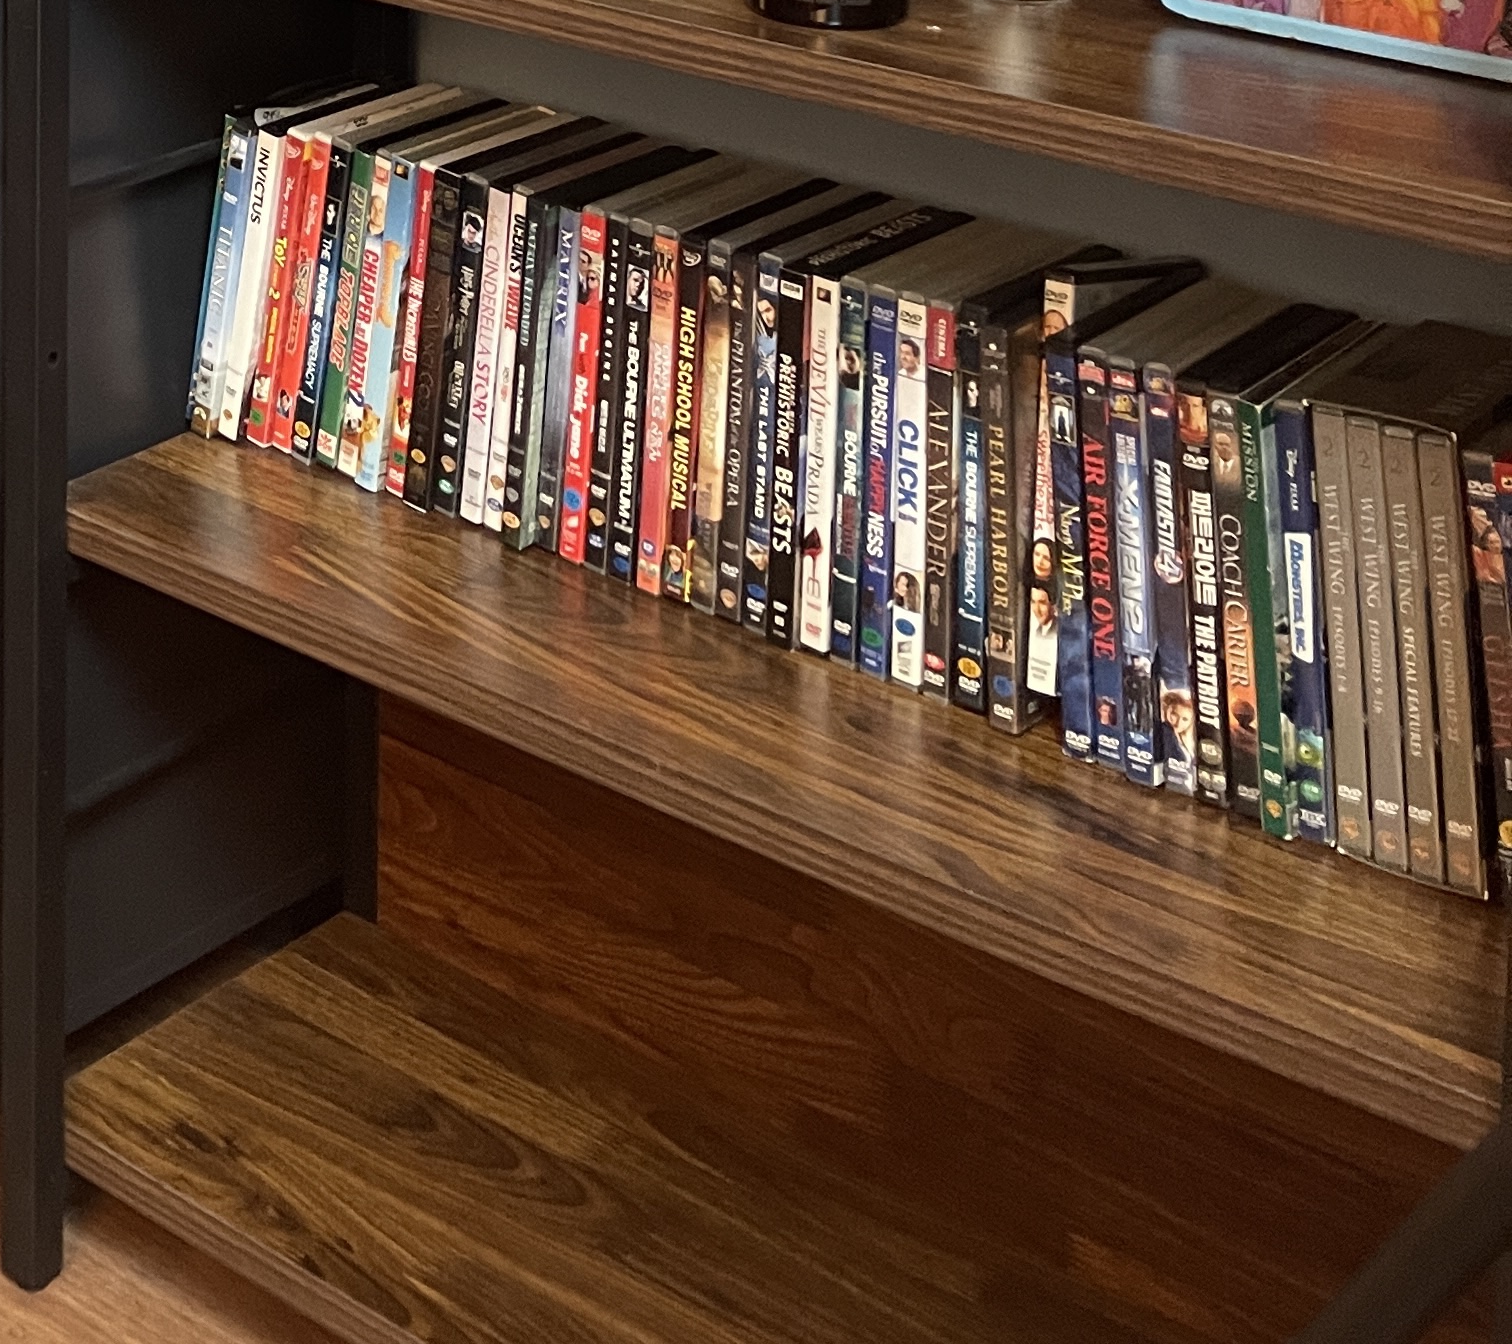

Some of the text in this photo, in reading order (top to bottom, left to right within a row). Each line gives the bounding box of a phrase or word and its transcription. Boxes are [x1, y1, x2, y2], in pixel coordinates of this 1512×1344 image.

[250, 147, 270, 224] INVICTUS
[209, 225, 234, 325] TITANIC
[269, 288, 280, 299] 2
[275, 238, 287, 268] TOY
[314, 264, 329, 317] BOURNE
[320, 239, 333, 262] THE
[357, 249, 381, 322] CHEAPER
[504, 275, 522, 333] TWELVE
[520, 275, 535, 347] RELOADED
[554, 230, 574, 326] MATRIX
[601, 238, 620, 382] BATMAN BEGINS
[296, 318, 322, 391] SUPREMACY
[349, 334, 369, 395] DOZEN
[403, 277, 424, 362] THE INCREDIBLES
[472, 244, 500, 425] CINDERELLA STORY
[935, 317, 946, 358] CINEMA
[571, 372, 590, 418] Dick
[617, 320, 639, 526] THE BOURNE ULTIMATUM
[670, 306, 696, 511] HIGH SCHOOL MUSICAL
[725, 338, 744, 507] PHANTOM OPERA
[753, 387, 770, 519] THE LAST STAND
[771, 354, 794, 555] PREHISTORIC BEASTS
[806, 329, 832, 517] THE DEVIL WEARS PRADA
[865, 352, 890, 557] the PURSUIT HAPPYNESS
[841, 429, 857, 497] BOURNE
[926, 399, 950, 576] ALEXANDER
[958, 430, 978, 608] THE BOURNE SUPREMACY
[988, 423, 1009, 609] PEARL HARBOR
[1153, 459, 1182, 580] FANTASTIC 4
[1241, 422, 1258, 502] MISSION
[1285, 448, 1299, 511] Disney PIXAR
[1059, 501, 1084, 616] Nanny McPhee
[1083, 433, 1115, 661] AIR FORCE ONE
[1219, 514, 1249, 688] COACH CARTER
[1324, 484, 1347, 669] WEST WING EPISODES
[1360, 497, 1383, 683] WEST WING EPISODES
[1189, 490, 1221, 729] 패트리어트 THE PATRIOT
[1393, 503, 1422, 758] WEST WING SPECIAL FEATURES
[1432, 514, 1458, 704] WEST WING EPISODES
